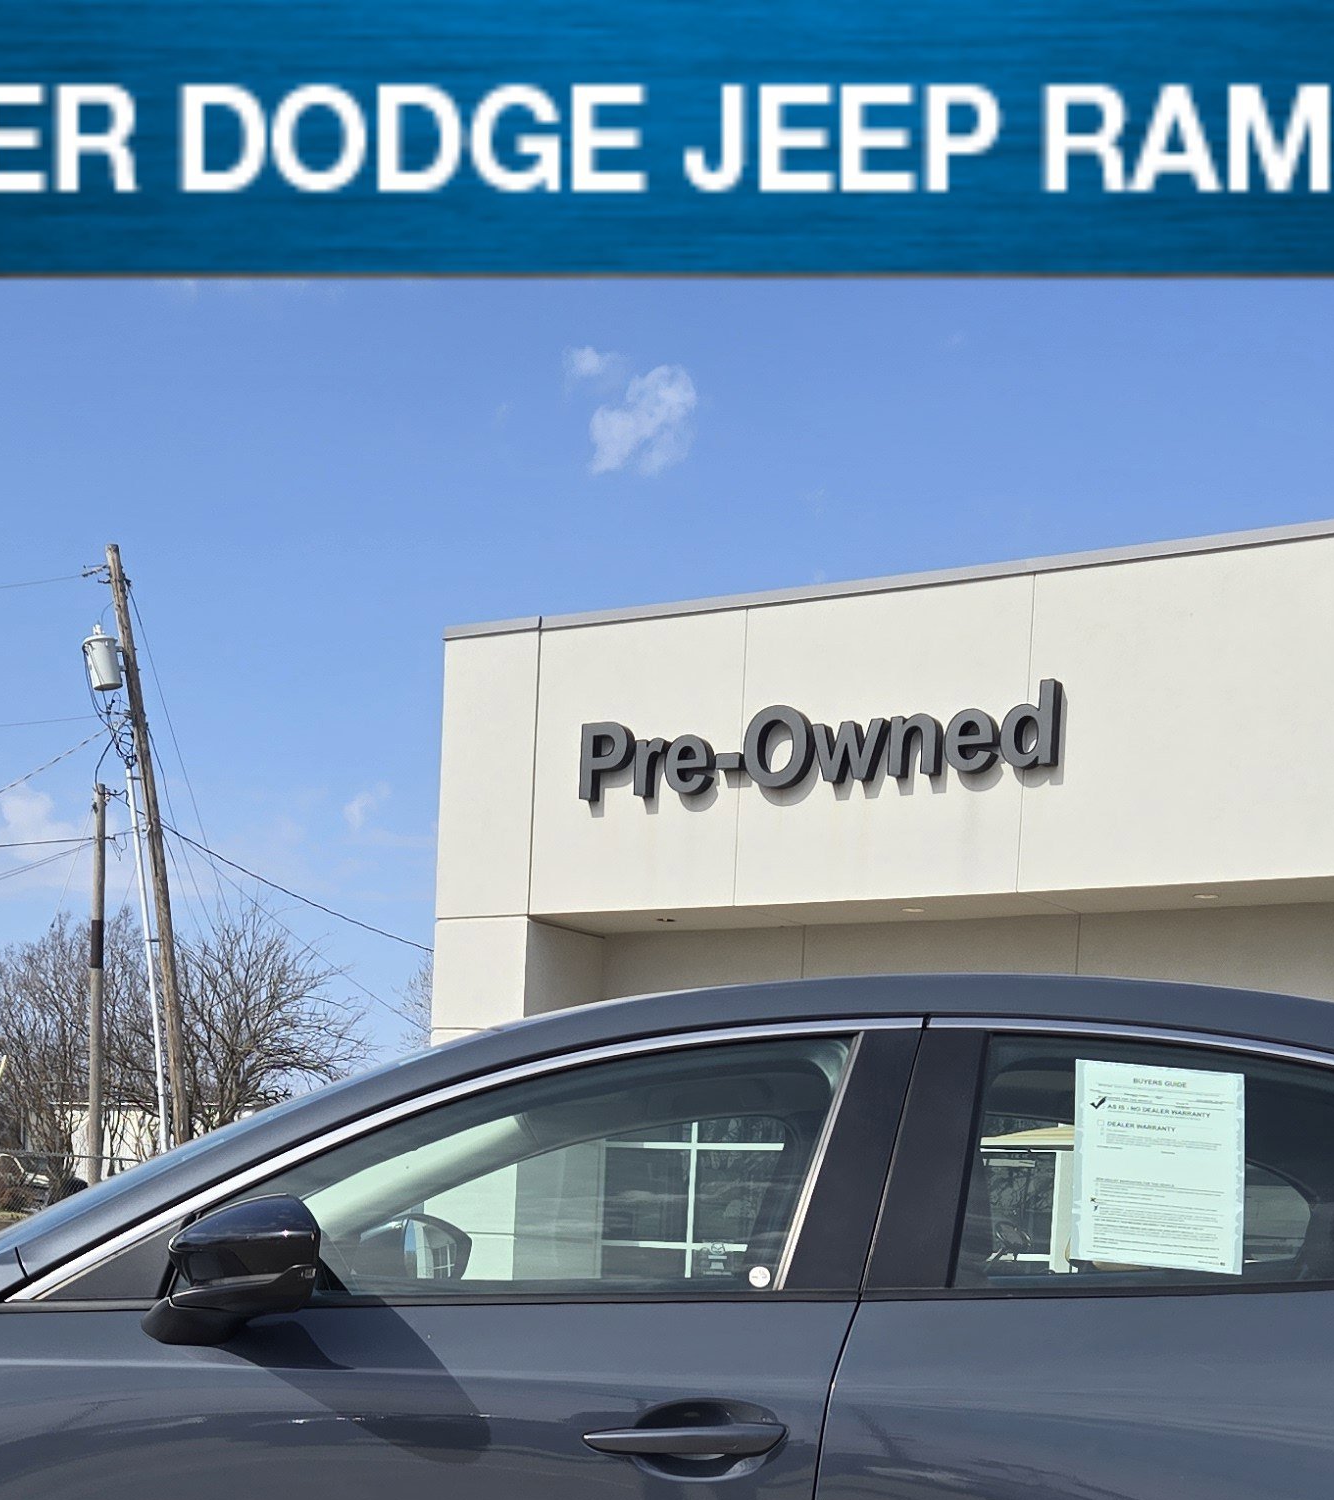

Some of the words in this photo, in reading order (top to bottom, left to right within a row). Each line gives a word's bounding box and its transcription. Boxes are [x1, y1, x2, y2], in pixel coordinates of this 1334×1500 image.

[578, 678, 1063, 802] Pre-Owned
[1132, 1077, 1163, 1087] BUYERS
[1164, 1080, 1188, 1089] GUIDE
[1142, 1107, 1170, 1115] DEALER
[1171, 1110, 1211, 1119] WARRANTY
[1107, 1121, 1135, 1129] DEALER
[1136, 1124, 1177, 1132] WARRANTY
